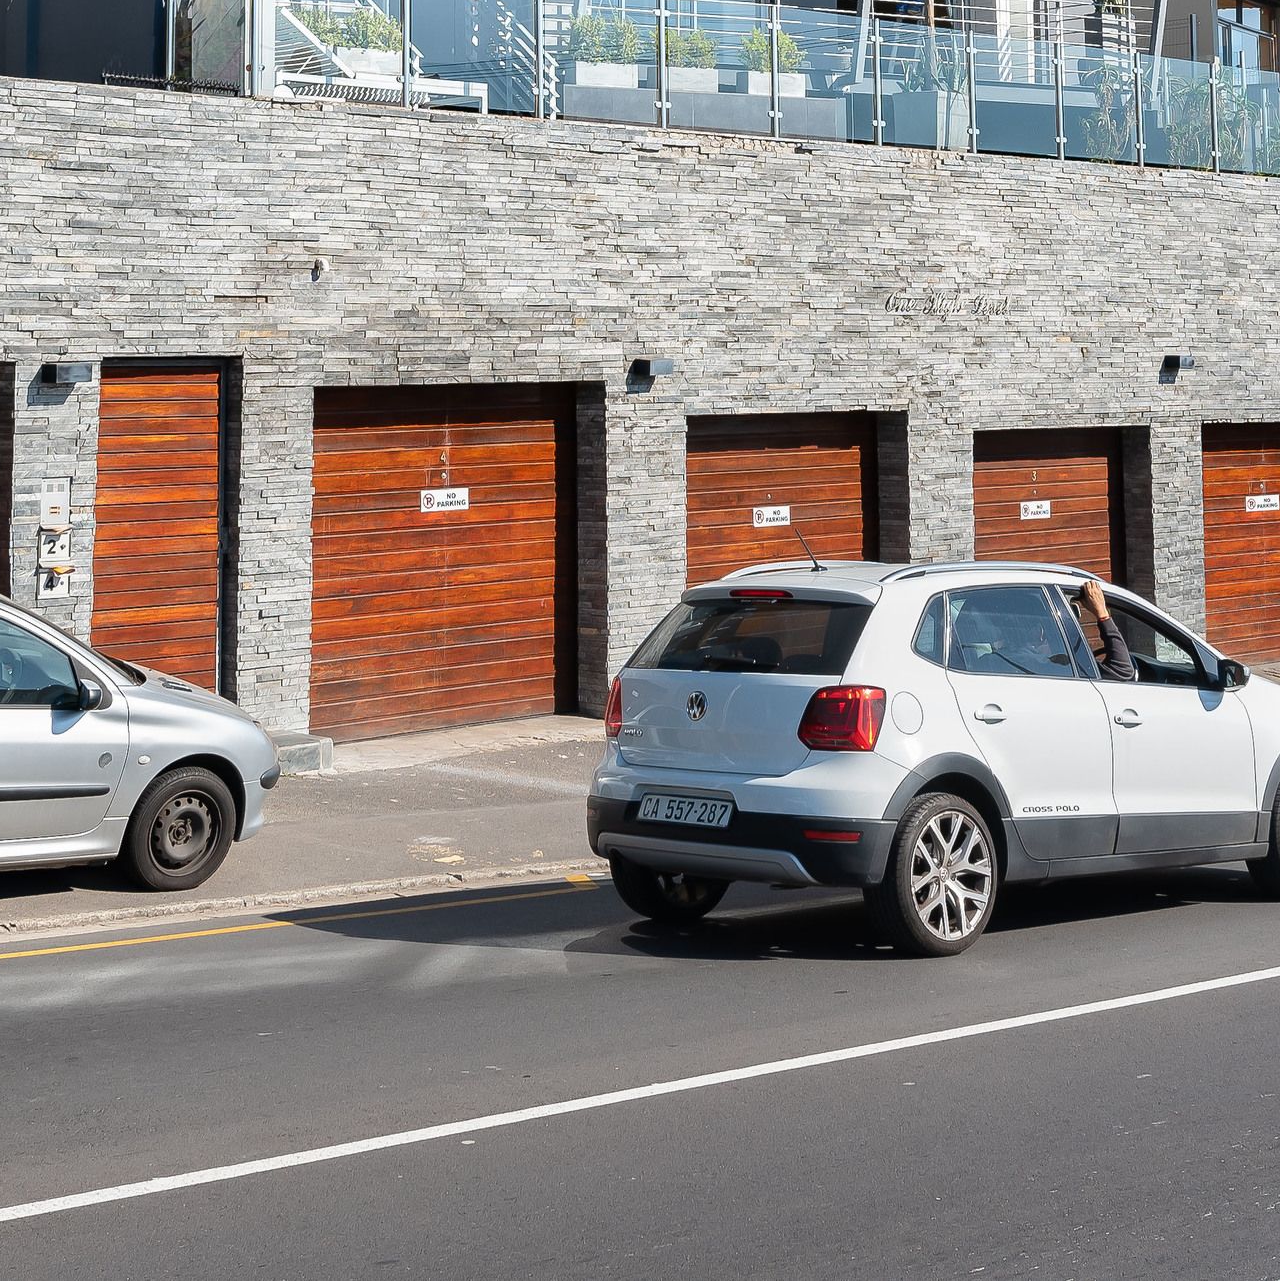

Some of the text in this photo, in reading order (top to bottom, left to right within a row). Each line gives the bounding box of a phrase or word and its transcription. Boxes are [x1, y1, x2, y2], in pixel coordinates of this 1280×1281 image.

[885, 290, 918, 313] One
[440, 451, 446, 462] 4
[1032, 470, 1037, 481] 3
[437, 499, 466, 508] PARKING
[47, 540, 56, 554] 2
[642, 798, 660, 818] CA
